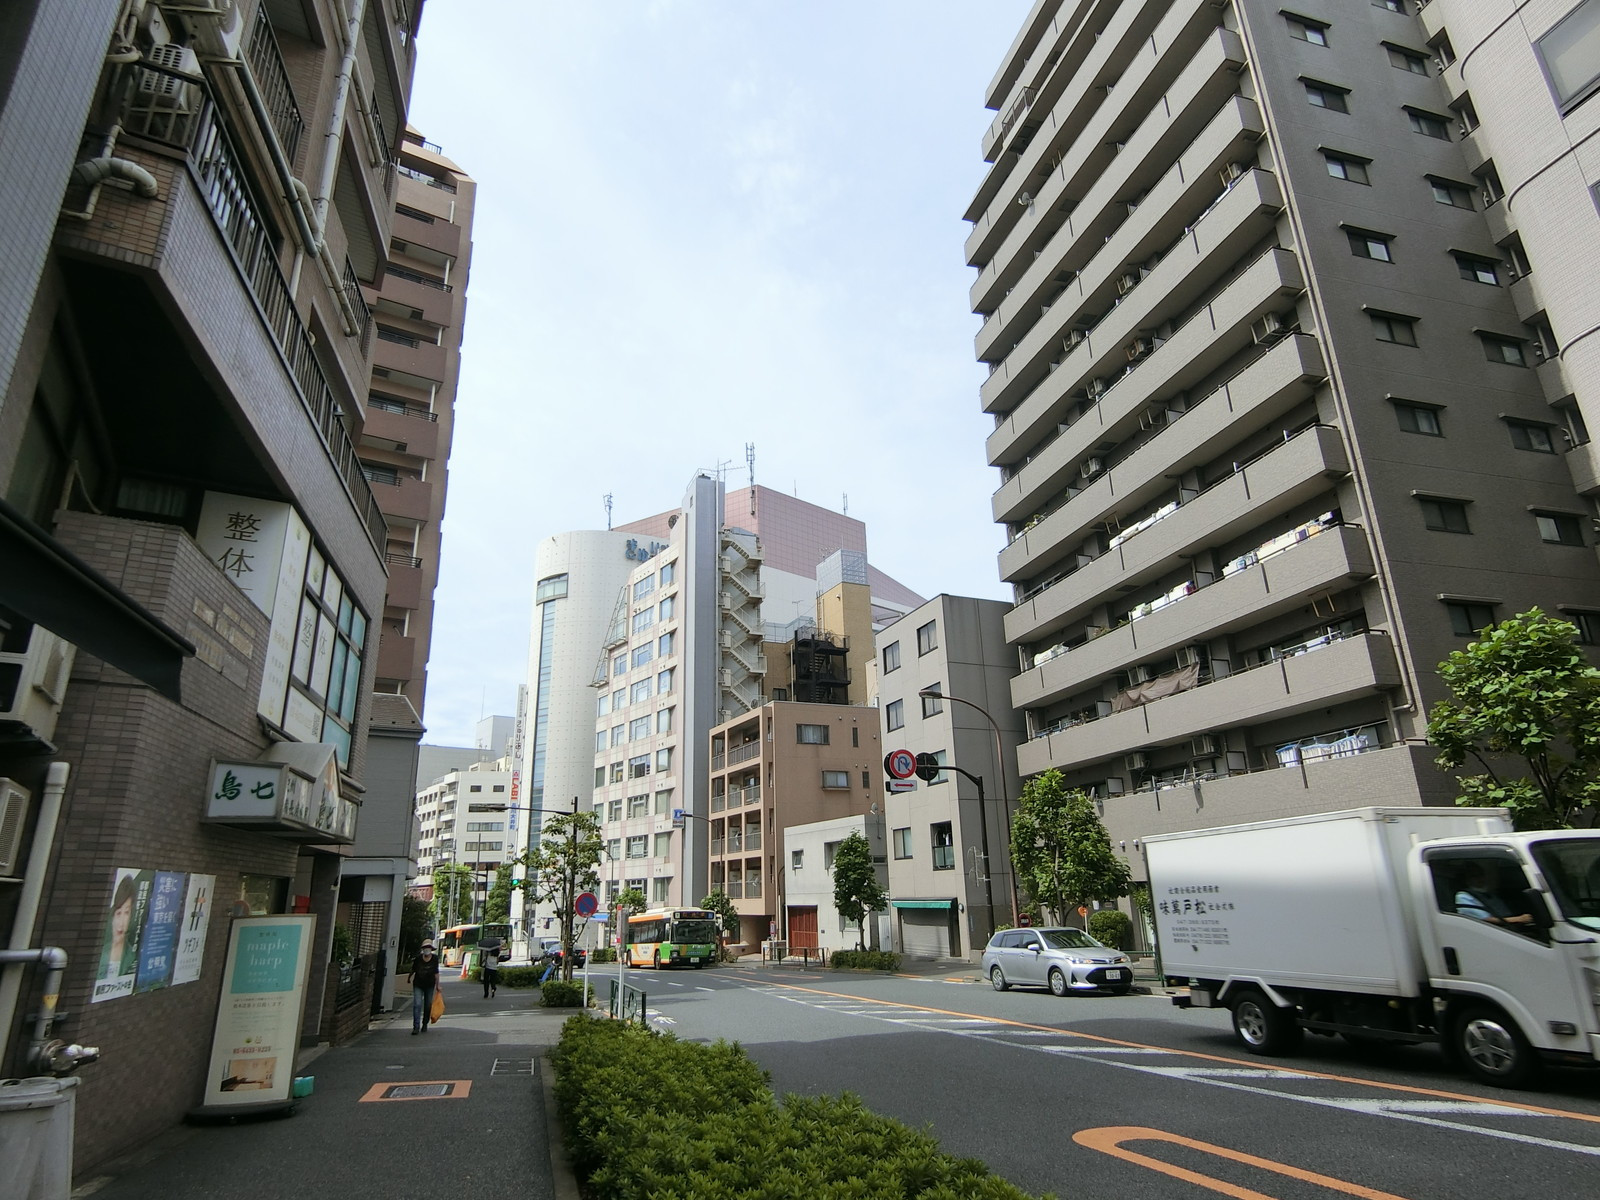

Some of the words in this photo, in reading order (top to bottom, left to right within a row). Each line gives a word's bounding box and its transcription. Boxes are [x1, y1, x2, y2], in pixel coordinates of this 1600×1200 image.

[217, 511, 262, 578] 整体
[511, 777, 519, 800] LABI
[247, 938, 289, 955] maple
